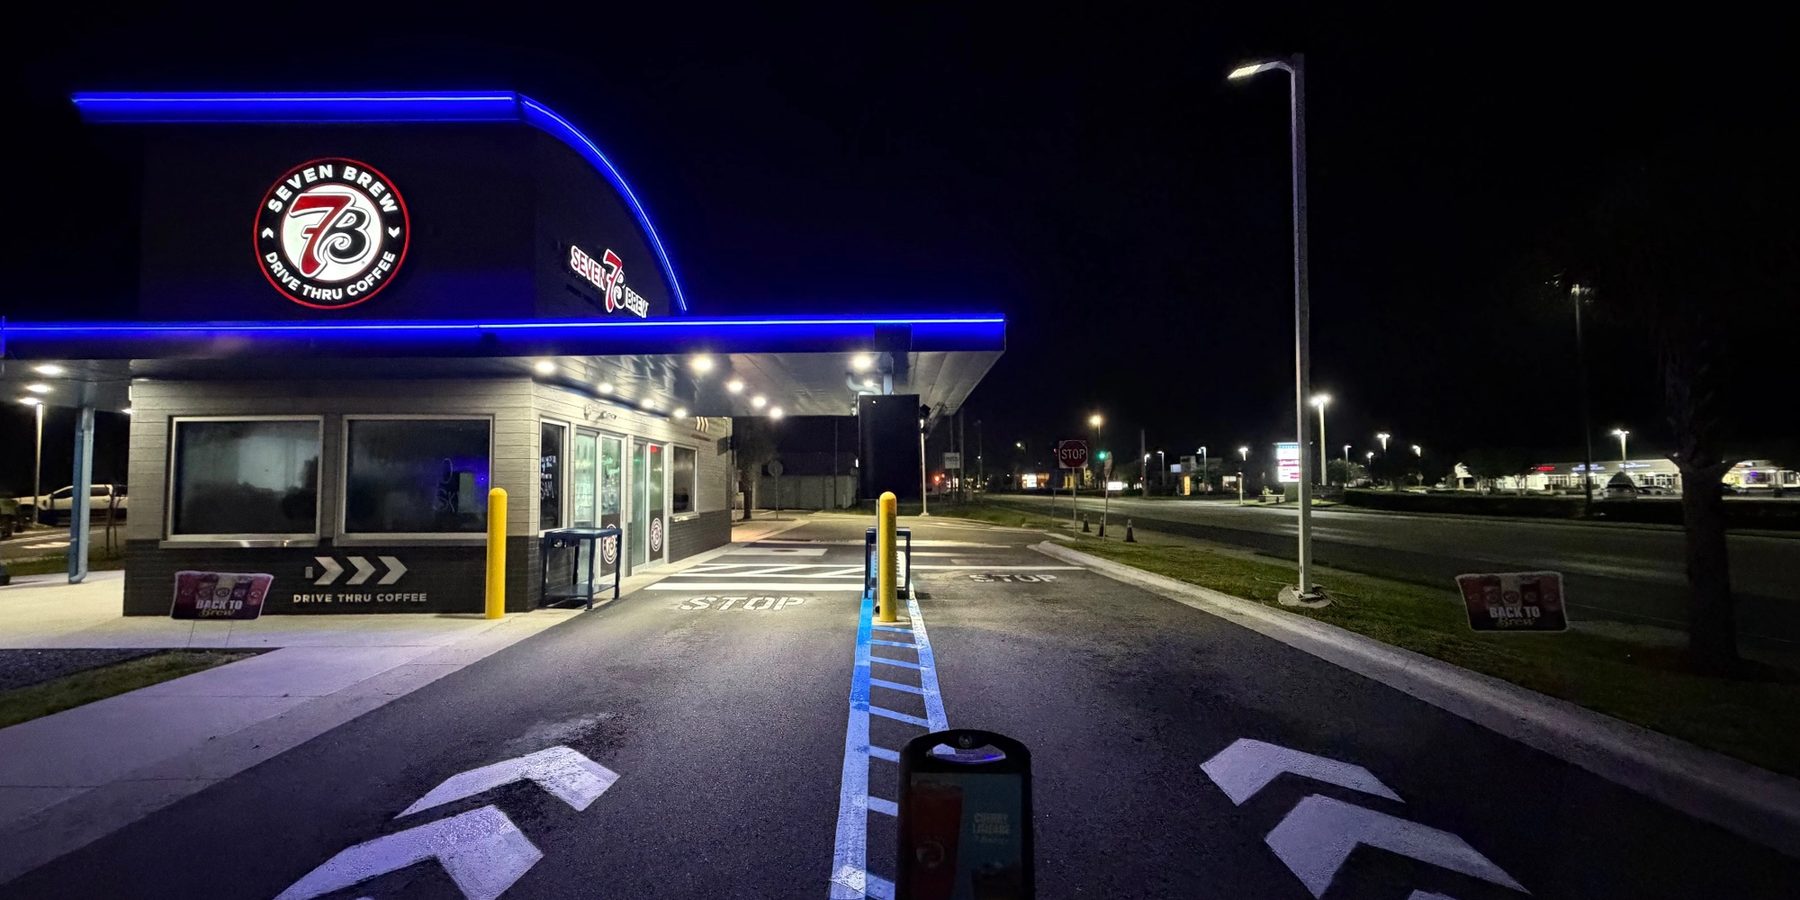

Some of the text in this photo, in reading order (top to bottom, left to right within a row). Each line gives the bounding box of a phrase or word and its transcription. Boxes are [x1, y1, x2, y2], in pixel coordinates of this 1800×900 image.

[267, 164, 399, 213] SEVEN BREW
[265, 250, 396, 301] DRIVE THRU COFFEE
[570, 245, 607, 291] SEVEN
[625, 286, 650, 319] BREW
[1061, 448, 1087, 460] STOP
[969, 574, 1057, 583] STOP
[195, 599, 244, 610] BACK TO
[292, 592, 427, 603] DRIVE THRU COFFEE
[680, 596, 805, 611] STOP
[1488, 605, 1541, 619] BACK TO
